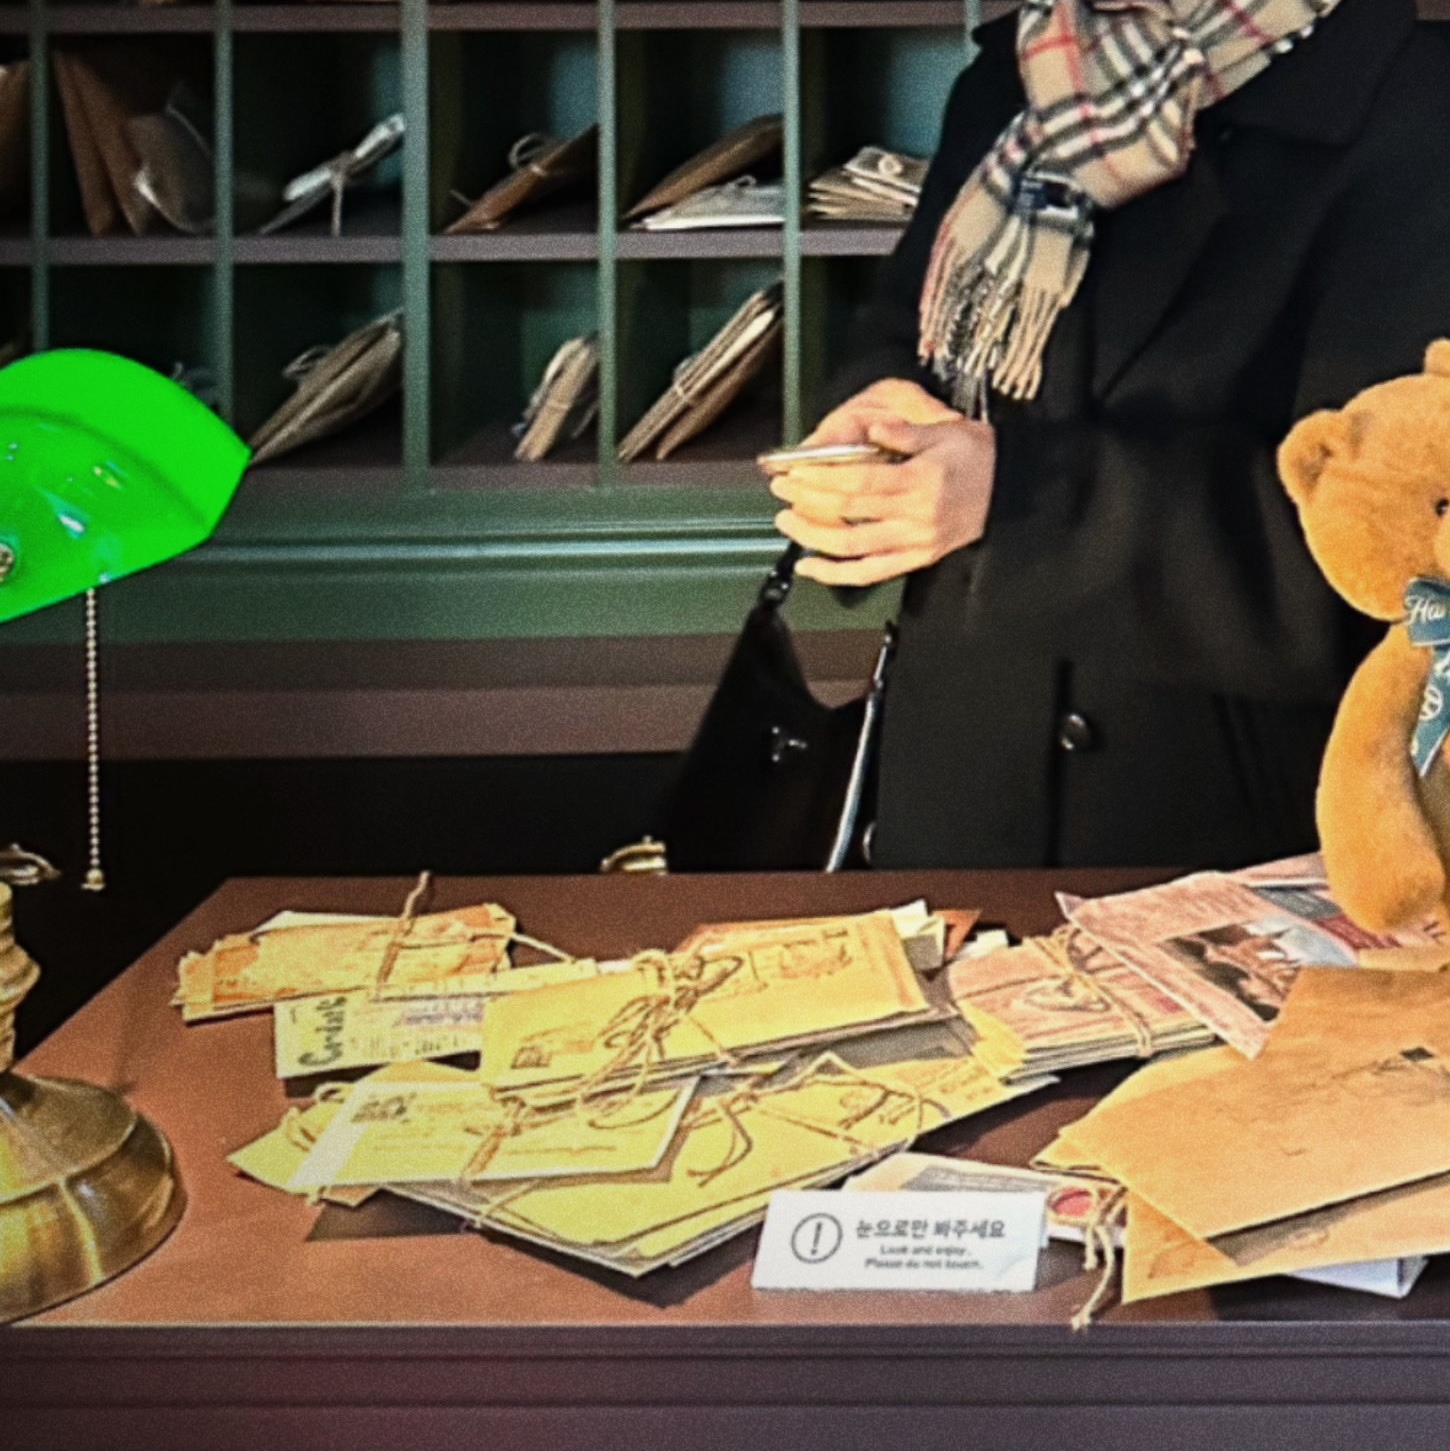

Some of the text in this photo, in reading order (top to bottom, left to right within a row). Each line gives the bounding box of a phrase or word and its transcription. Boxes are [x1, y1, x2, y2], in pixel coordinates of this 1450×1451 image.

[856, 1219, 928, 1239] 눈으로만
[880, 1245, 909, 1255] Look
[912, 1245, 933, 1255] and
[865, 1258, 904, 1269] Please
[906, 1258, 920, 1269] do
[923, 1259, 942, 1269] not
